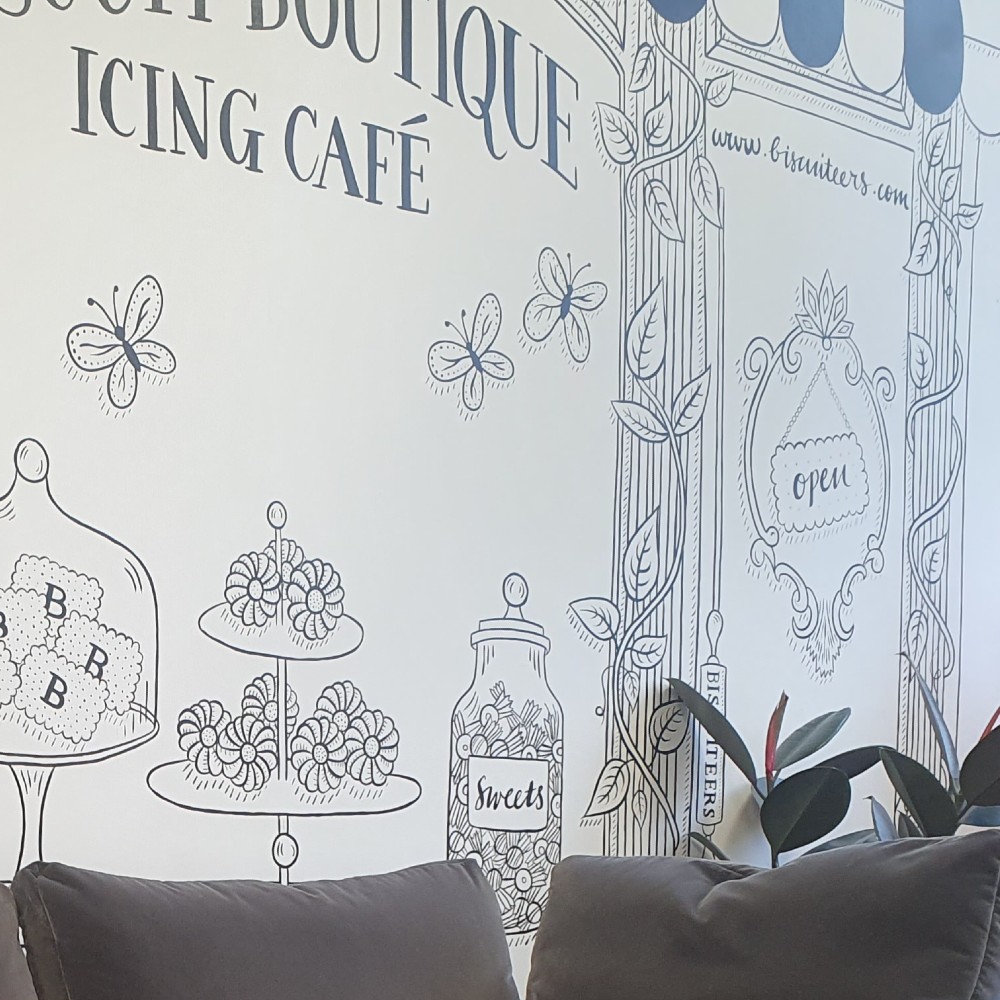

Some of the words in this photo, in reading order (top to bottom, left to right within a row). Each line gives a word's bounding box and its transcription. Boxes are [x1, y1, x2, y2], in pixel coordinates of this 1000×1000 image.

[70, 46, 266, 174] ICING
[284, 112, 431, 215] CAFÉ
[711, 127, 910, 211] www.biscuiteers.com
[792, 463, 851, 508] open
[44, 582, 68, 620] B
[39, 670, 69, 710] B
[703, 671, 720, 818] BISITEERS
[474, 774, 544, 811] Sweets
